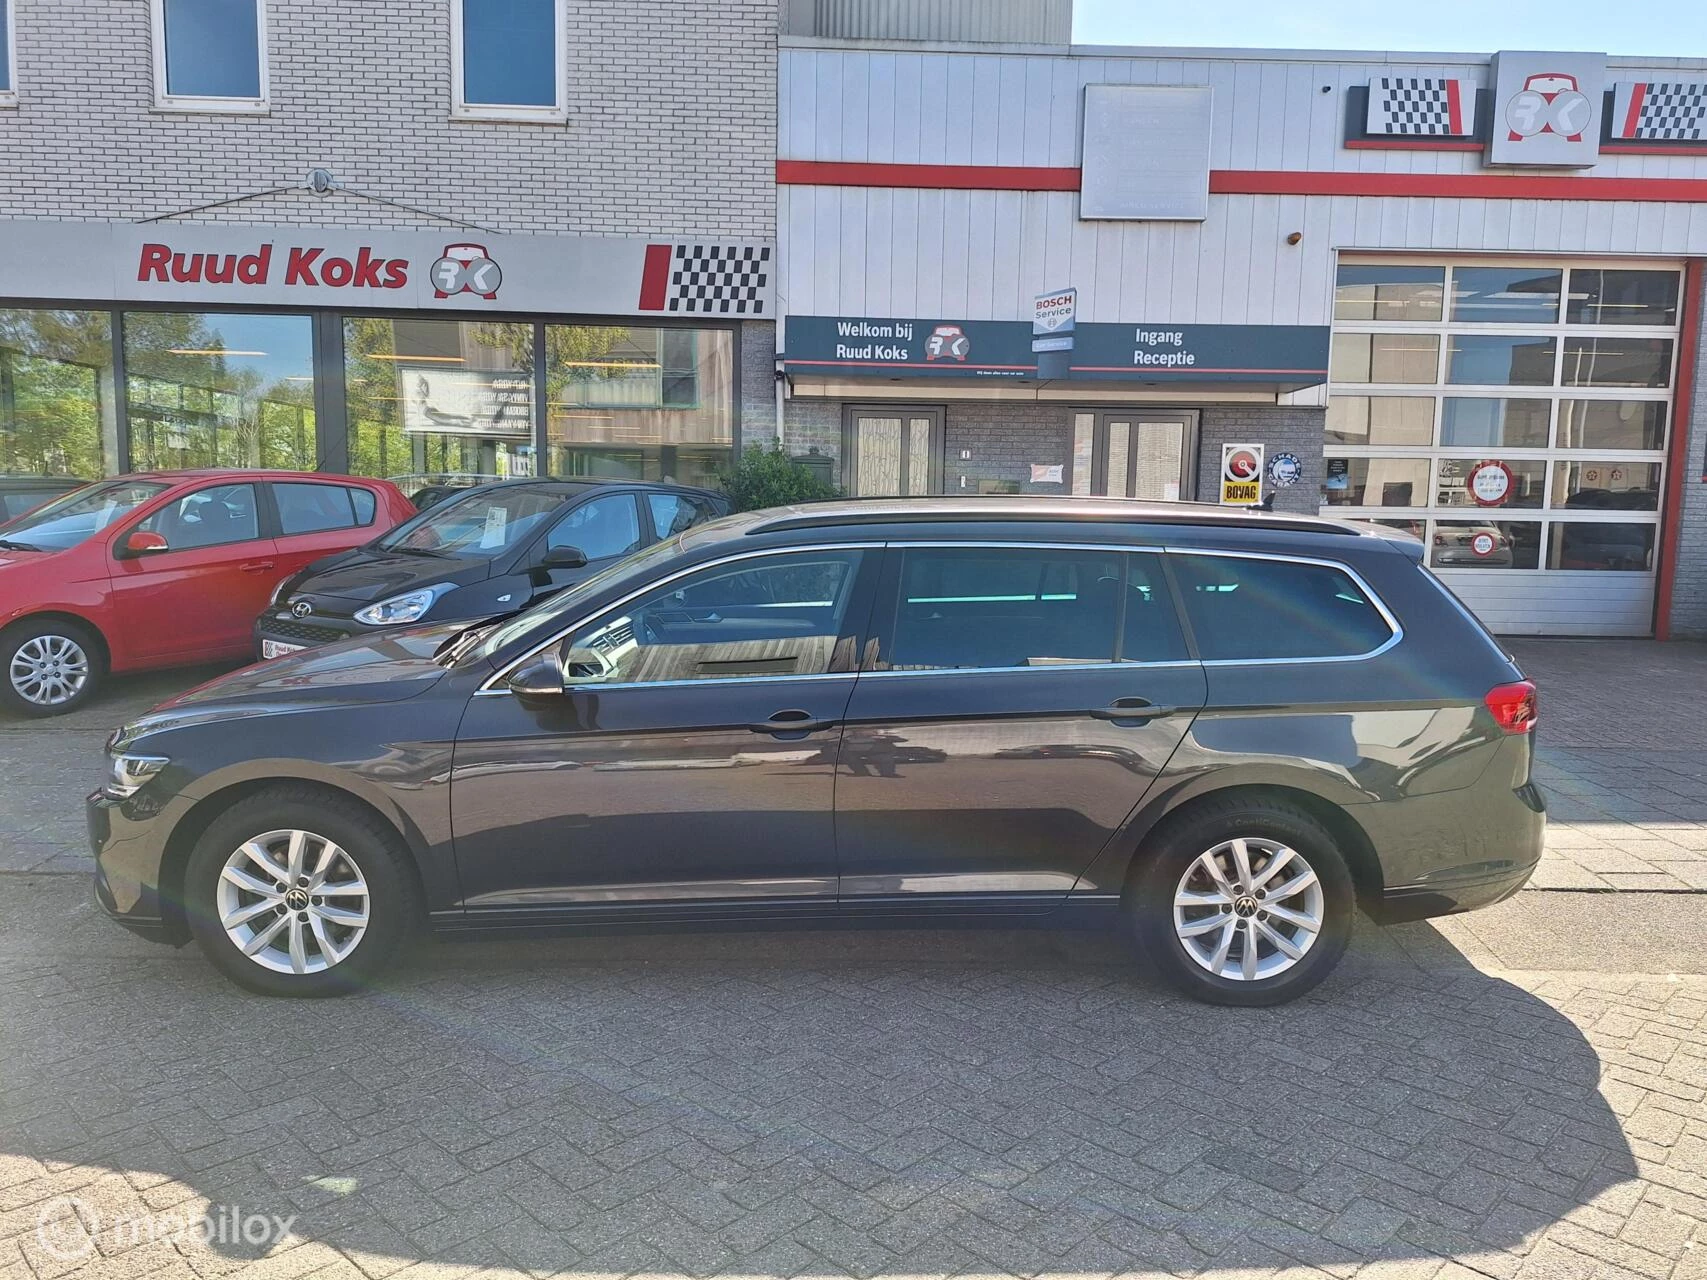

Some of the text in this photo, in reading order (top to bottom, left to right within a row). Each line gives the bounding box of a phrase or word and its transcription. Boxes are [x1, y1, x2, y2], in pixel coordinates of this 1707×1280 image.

[137, 243, 410, 289] Ruud Koks
[1036, 295, 1072, 310] BOSCH
[1035, 307, 1072, 319] Service
[837, 321, 913, 341] Welkom bij
[1135, 328, 1183, 346] Ingang
[836, 344, 908, 360] Ruud Koks
[1133, 350, 1195, 368] Receptie
[1226, 485, 1256, 499] BOVAG
